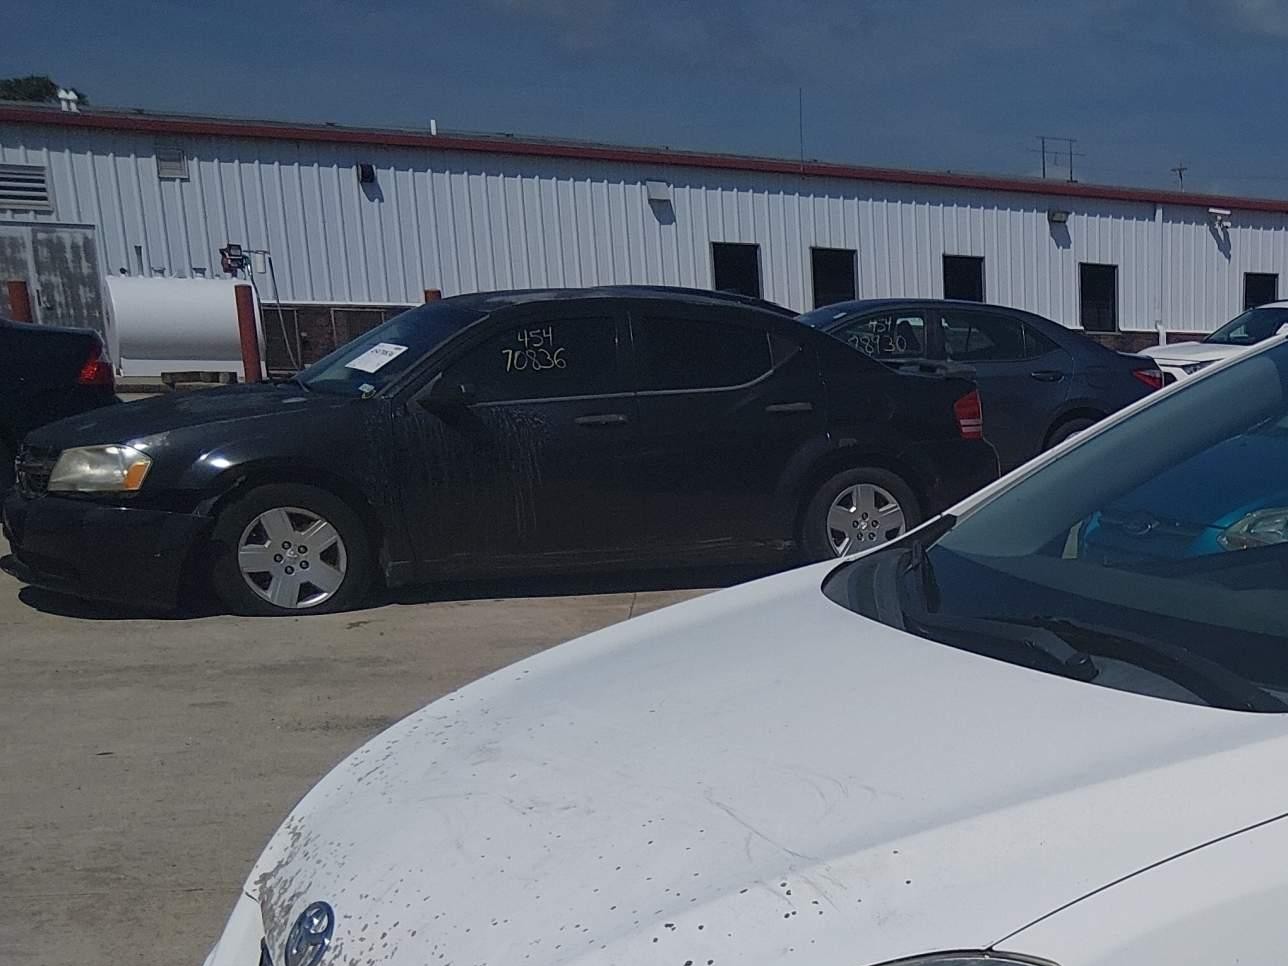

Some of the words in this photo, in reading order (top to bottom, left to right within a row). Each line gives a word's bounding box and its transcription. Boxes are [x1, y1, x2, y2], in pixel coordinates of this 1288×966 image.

[869, 316, 892, 332] 454
[517, 325, 553, 348] 454
[502, 347, 566, 371] 70836
